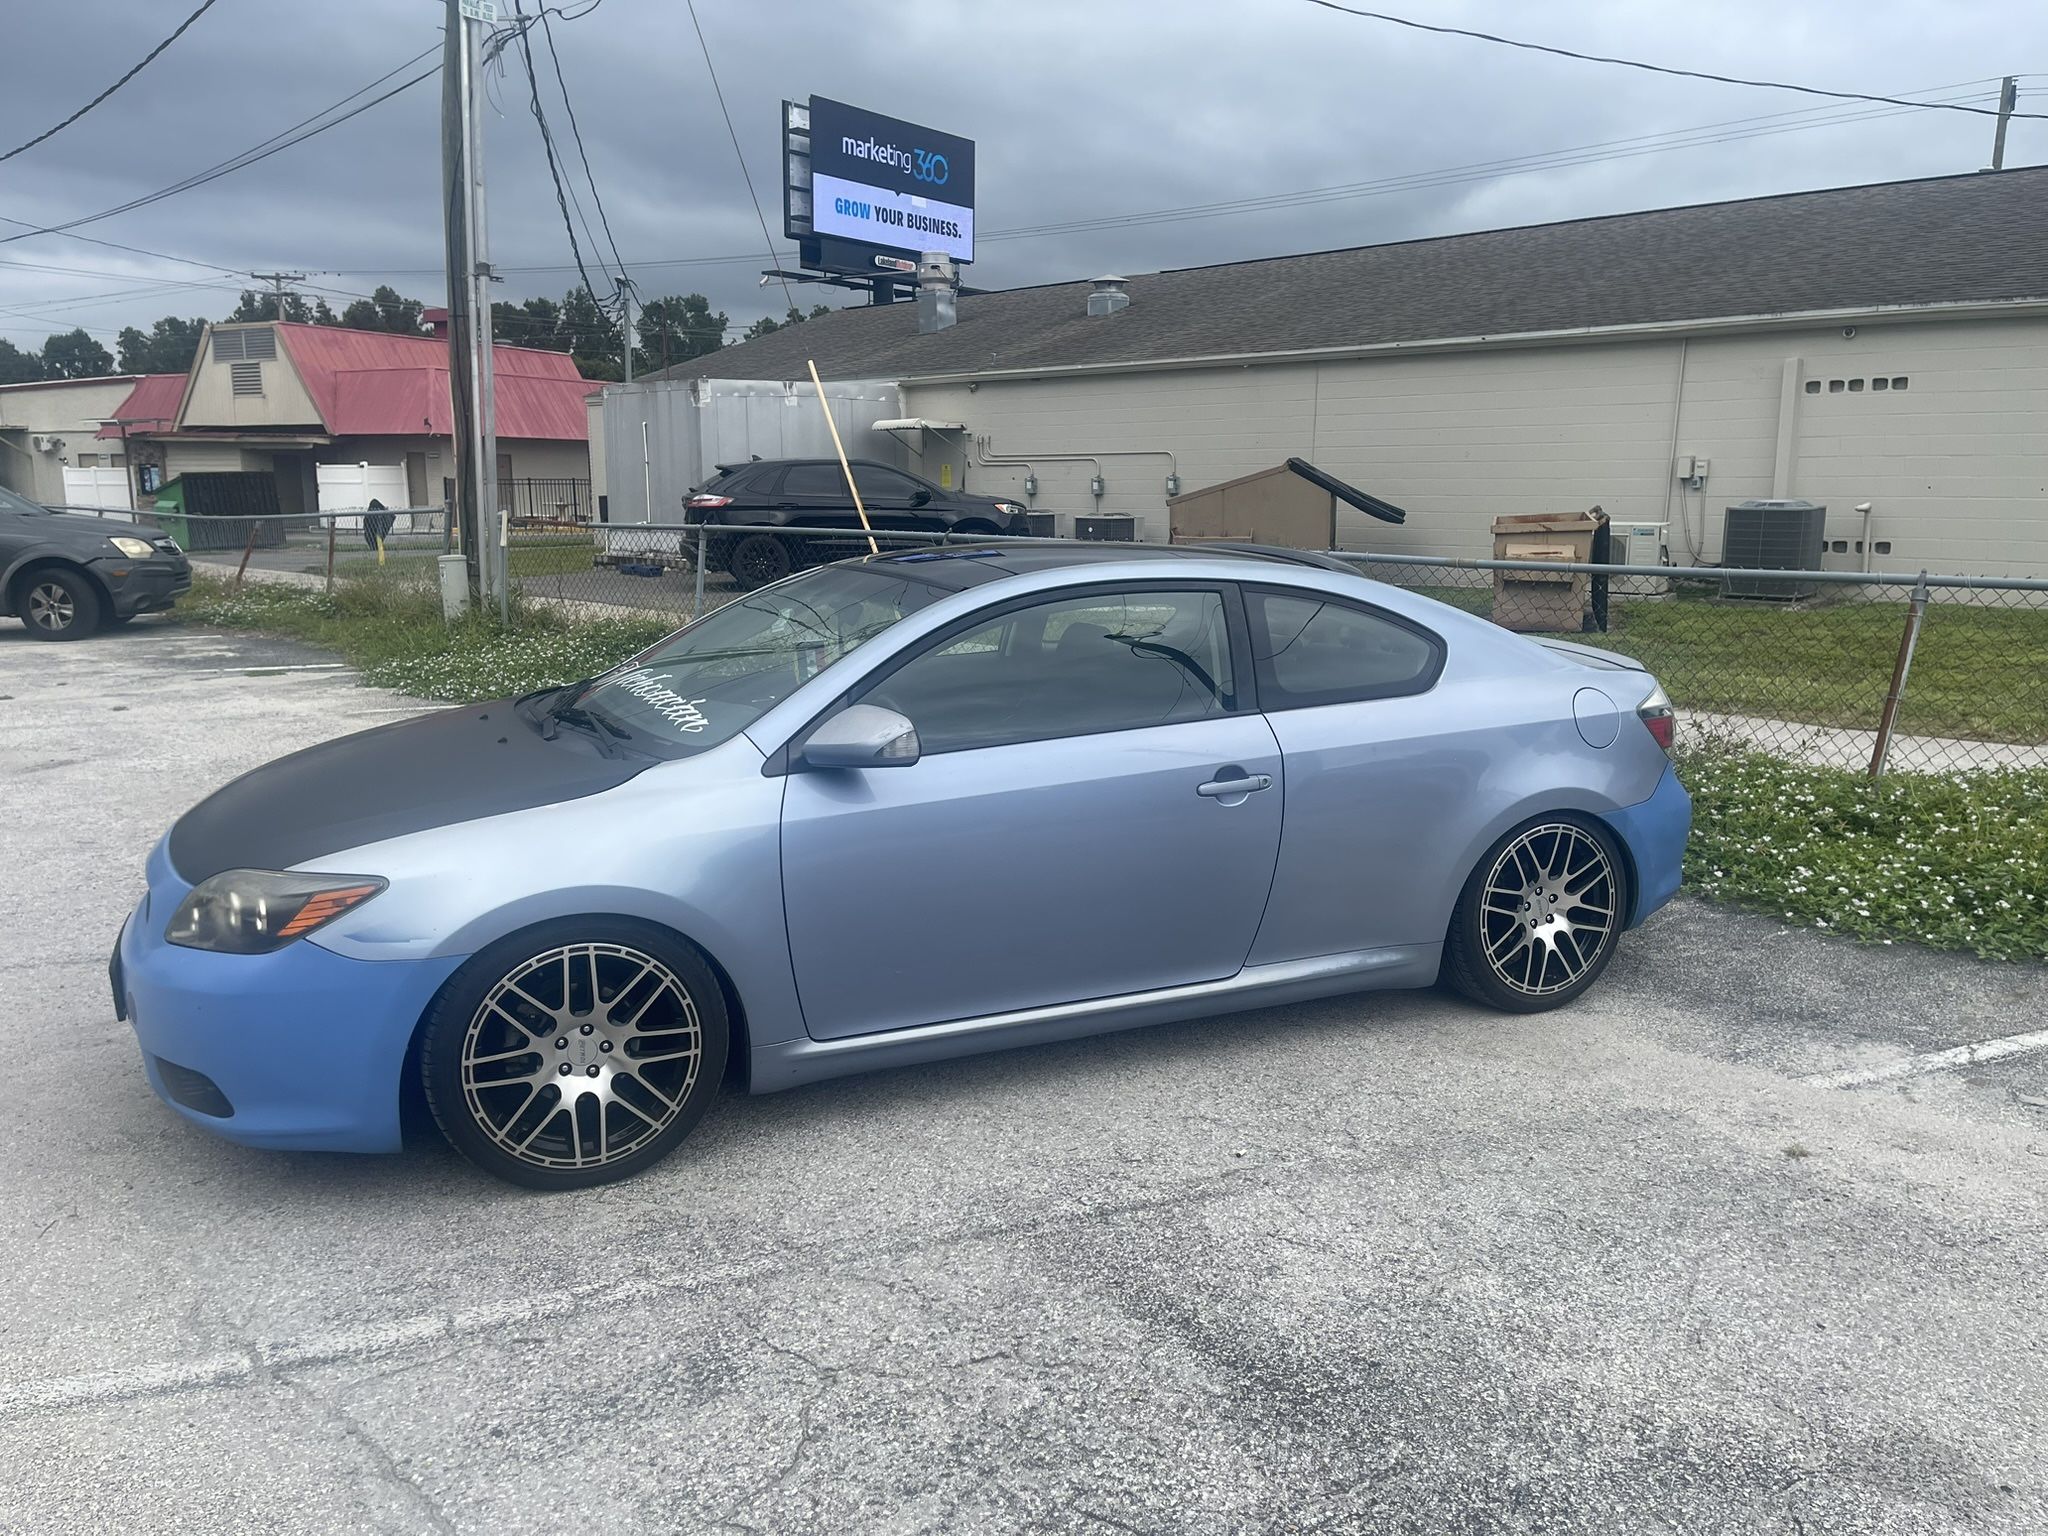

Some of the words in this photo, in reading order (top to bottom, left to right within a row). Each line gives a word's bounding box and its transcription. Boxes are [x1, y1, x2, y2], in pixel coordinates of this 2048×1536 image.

[842, 136, 911, 174] marketing
[913, 148, 948, 185] 360
[835, 197, 871, 219] GROW
[874, 205, 904, 228] YOUR
[907, 212, 962, 239] BUSINESS.
